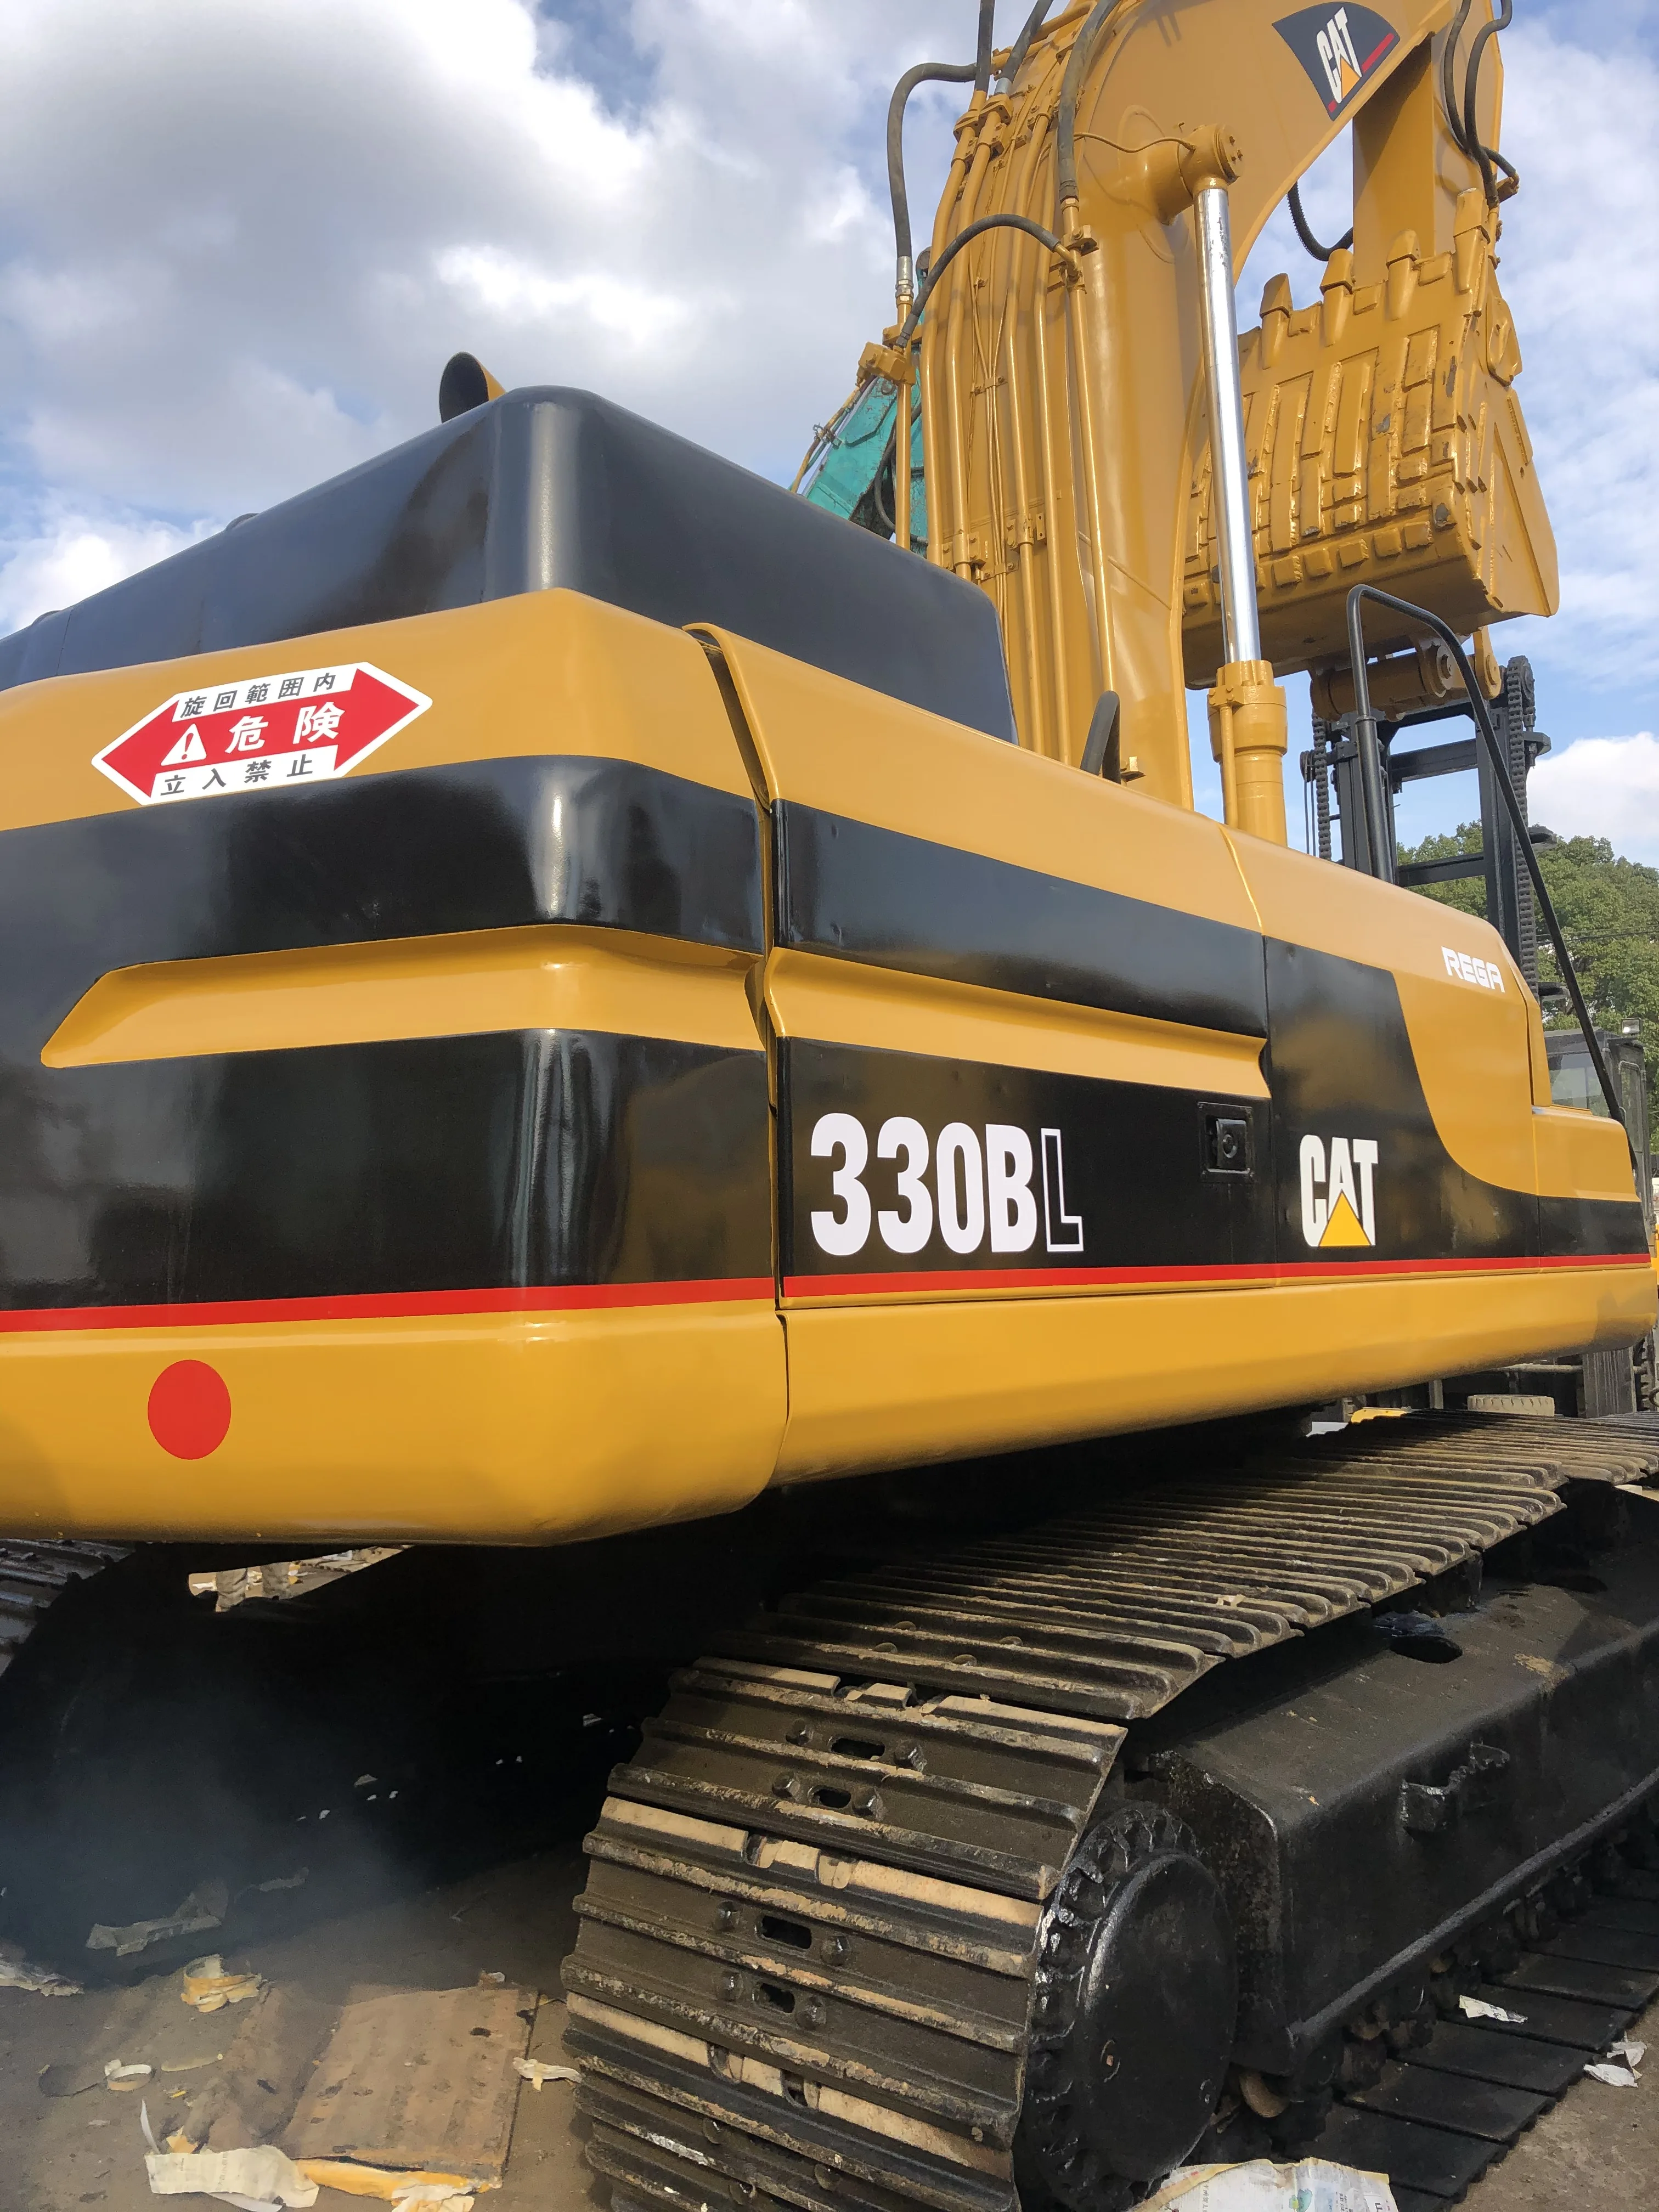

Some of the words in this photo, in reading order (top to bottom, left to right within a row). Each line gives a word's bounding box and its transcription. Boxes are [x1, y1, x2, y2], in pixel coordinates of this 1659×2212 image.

[1317, 7, 1362, 103] CAT
[180, 673, 336, 719] 旋回範囲内
[225, 702, 345, 753] 危険
[160, 754, 313, 796] 立入禁止
[1441, 946, 1505, 993] REGA
[811, 1113, 1084, 1256] 330BL
[1300, 1135, 1379, 1247] CAT
